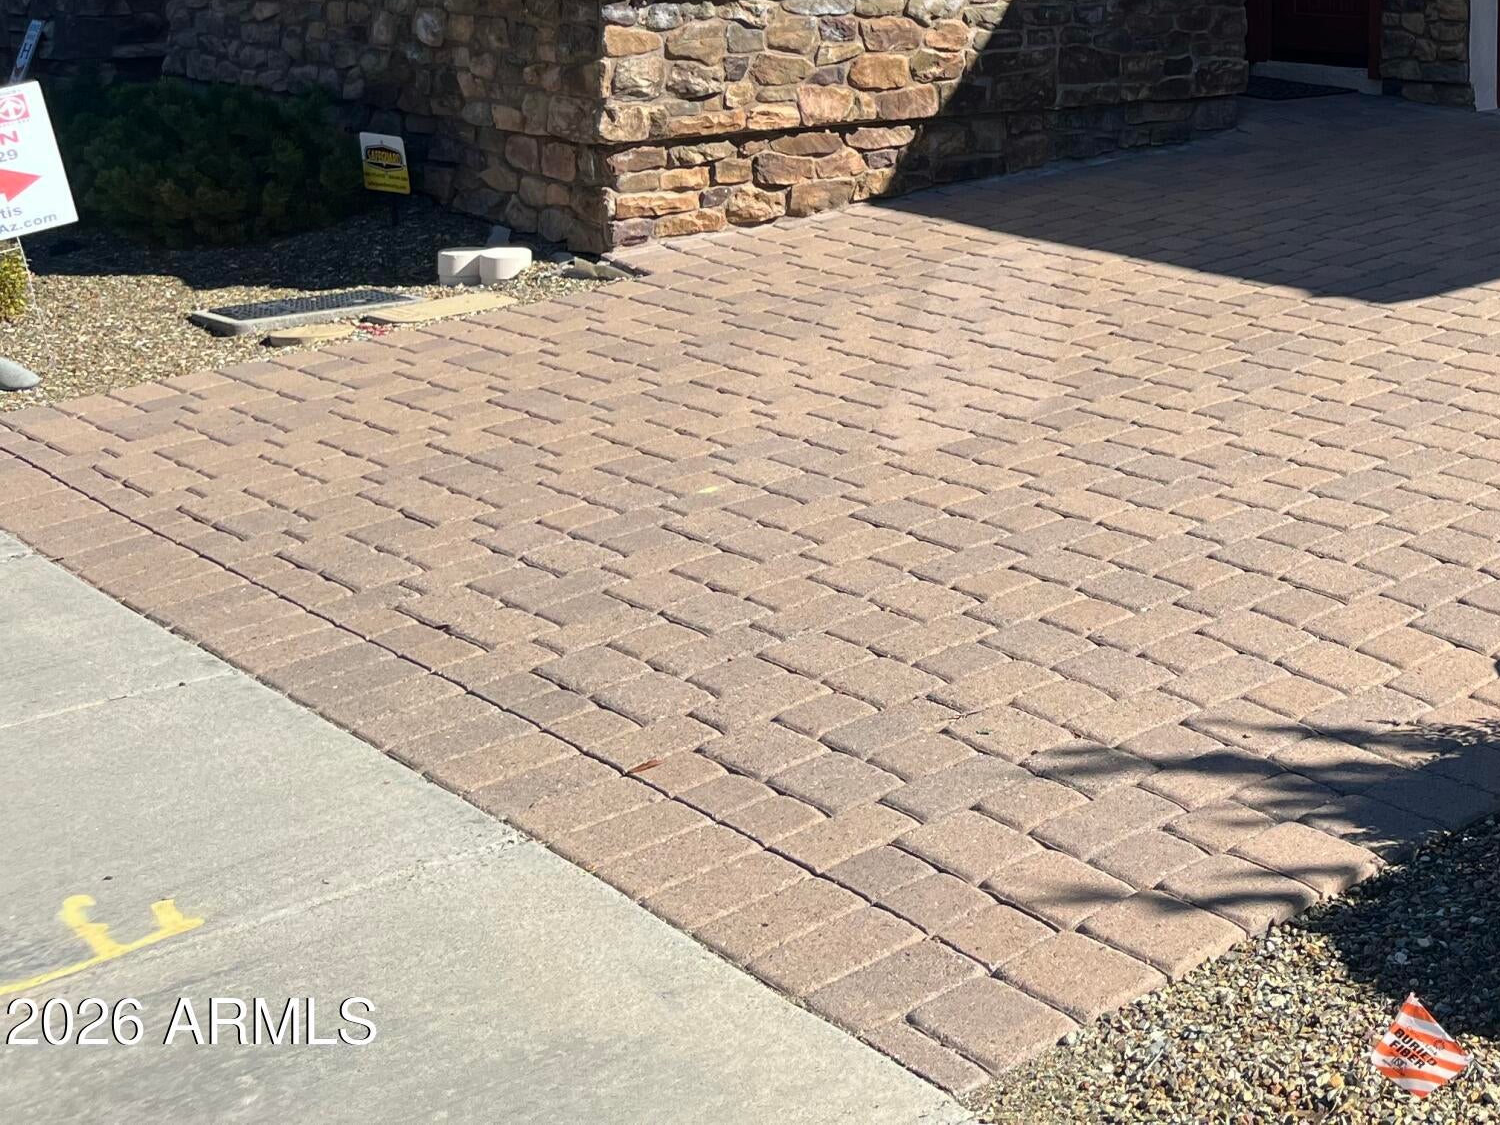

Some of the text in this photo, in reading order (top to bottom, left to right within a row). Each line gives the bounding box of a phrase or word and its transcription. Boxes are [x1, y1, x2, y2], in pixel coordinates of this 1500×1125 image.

[368, 148, 401, 164] SAFEGUARD
[1389, 1039, 1425, 1069] FIBER
[1394, 1028, 1437, 1067] BURIED
